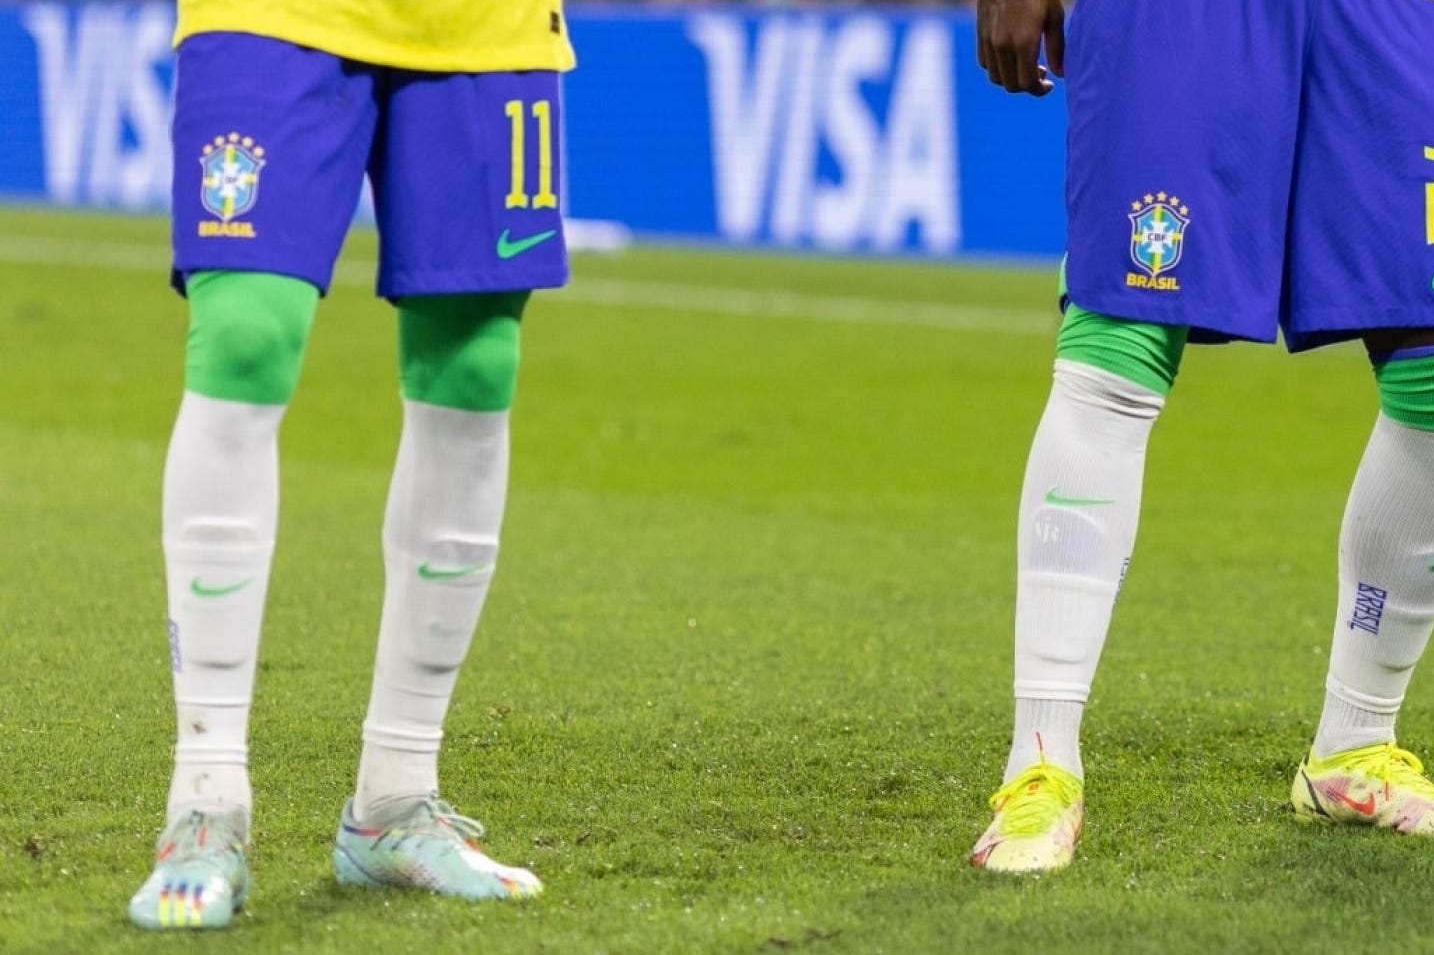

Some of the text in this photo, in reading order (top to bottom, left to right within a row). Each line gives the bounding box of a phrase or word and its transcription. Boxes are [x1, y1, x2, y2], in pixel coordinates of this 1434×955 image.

[505, 100, 558, 210] 11
[683, 12, 963, 252] VISA
[1126, 272, 1180, 290] BRASIL
[1350, 582, 1388, 635] BRASIL
